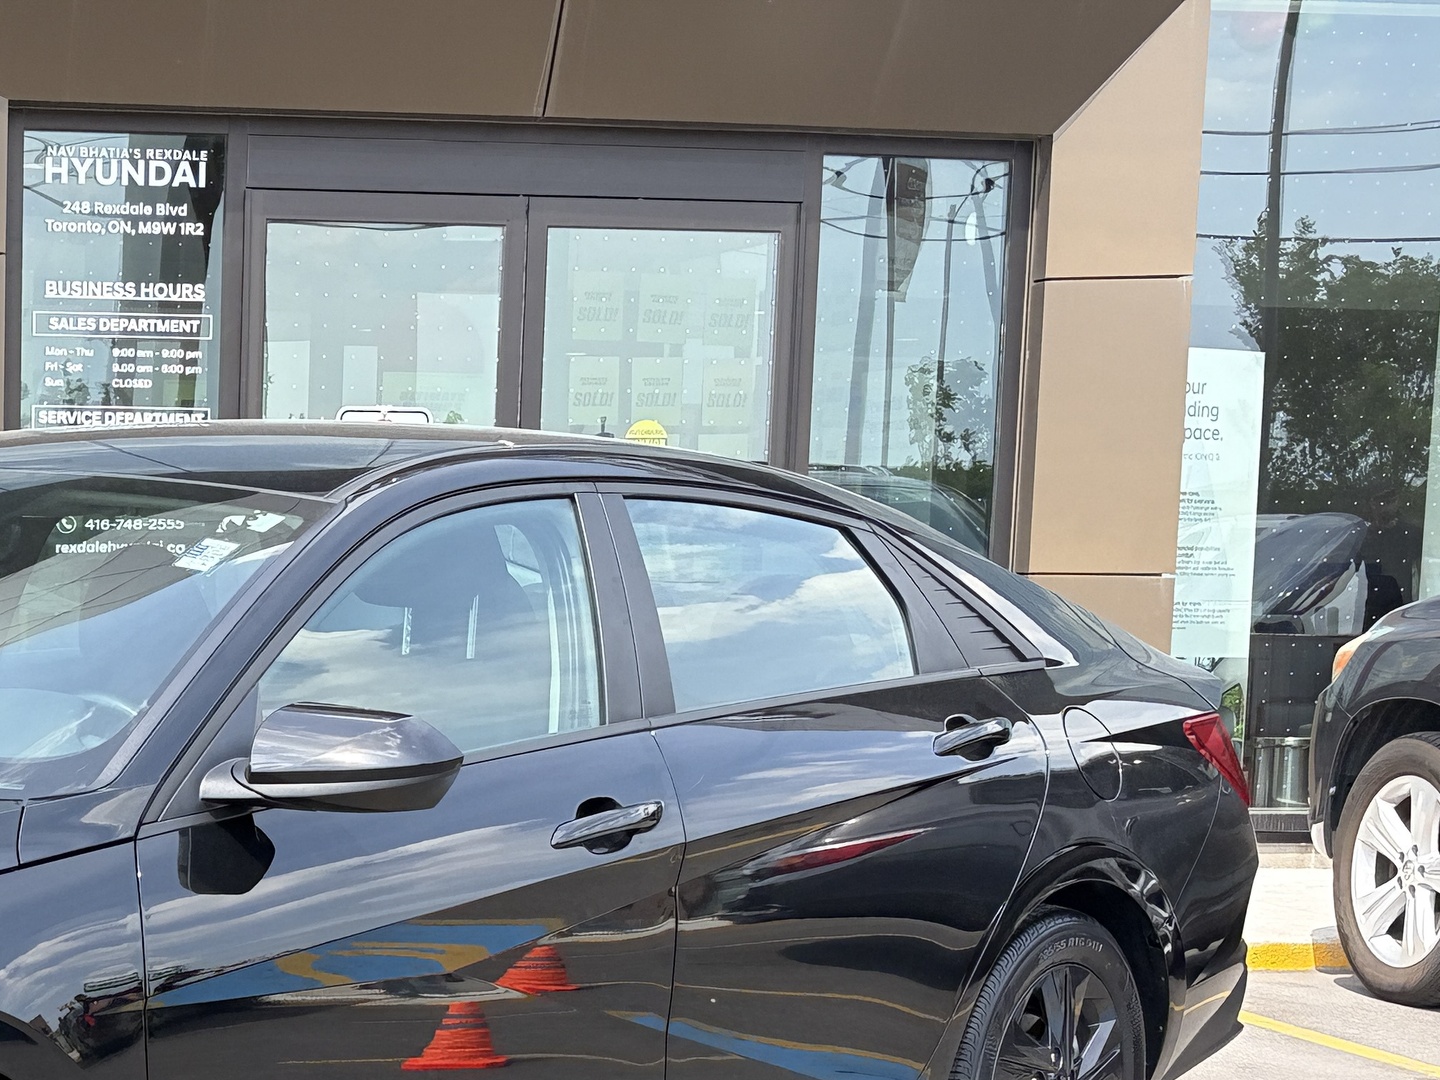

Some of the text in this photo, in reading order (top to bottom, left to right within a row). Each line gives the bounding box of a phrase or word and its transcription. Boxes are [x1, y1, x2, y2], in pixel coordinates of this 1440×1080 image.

[47, 146, 208, 161] NAV BHATIA'S REXDALE
[44, 157, 207, 188] HYUNDAI
[62, 200, 188, 217] 248 Rexdale Blvd
[45, 218, 205, 236] Toronto, ON, M9W 1R2
[44, 280, 206, 299] BUSINESS HOURS
[48, 316, 201, 333] SALES DEPARTMENT
[75, 346, 94, 357] Thu
[112, 378, 153, 388] CLOSED
[1185, 381, 1207, 395] our
[38, 410, 205, 425] SERVICE DEPARTMENT
[1187, 400, 1219, 422] ding
[1184, 427, 1223, 441] pace.
